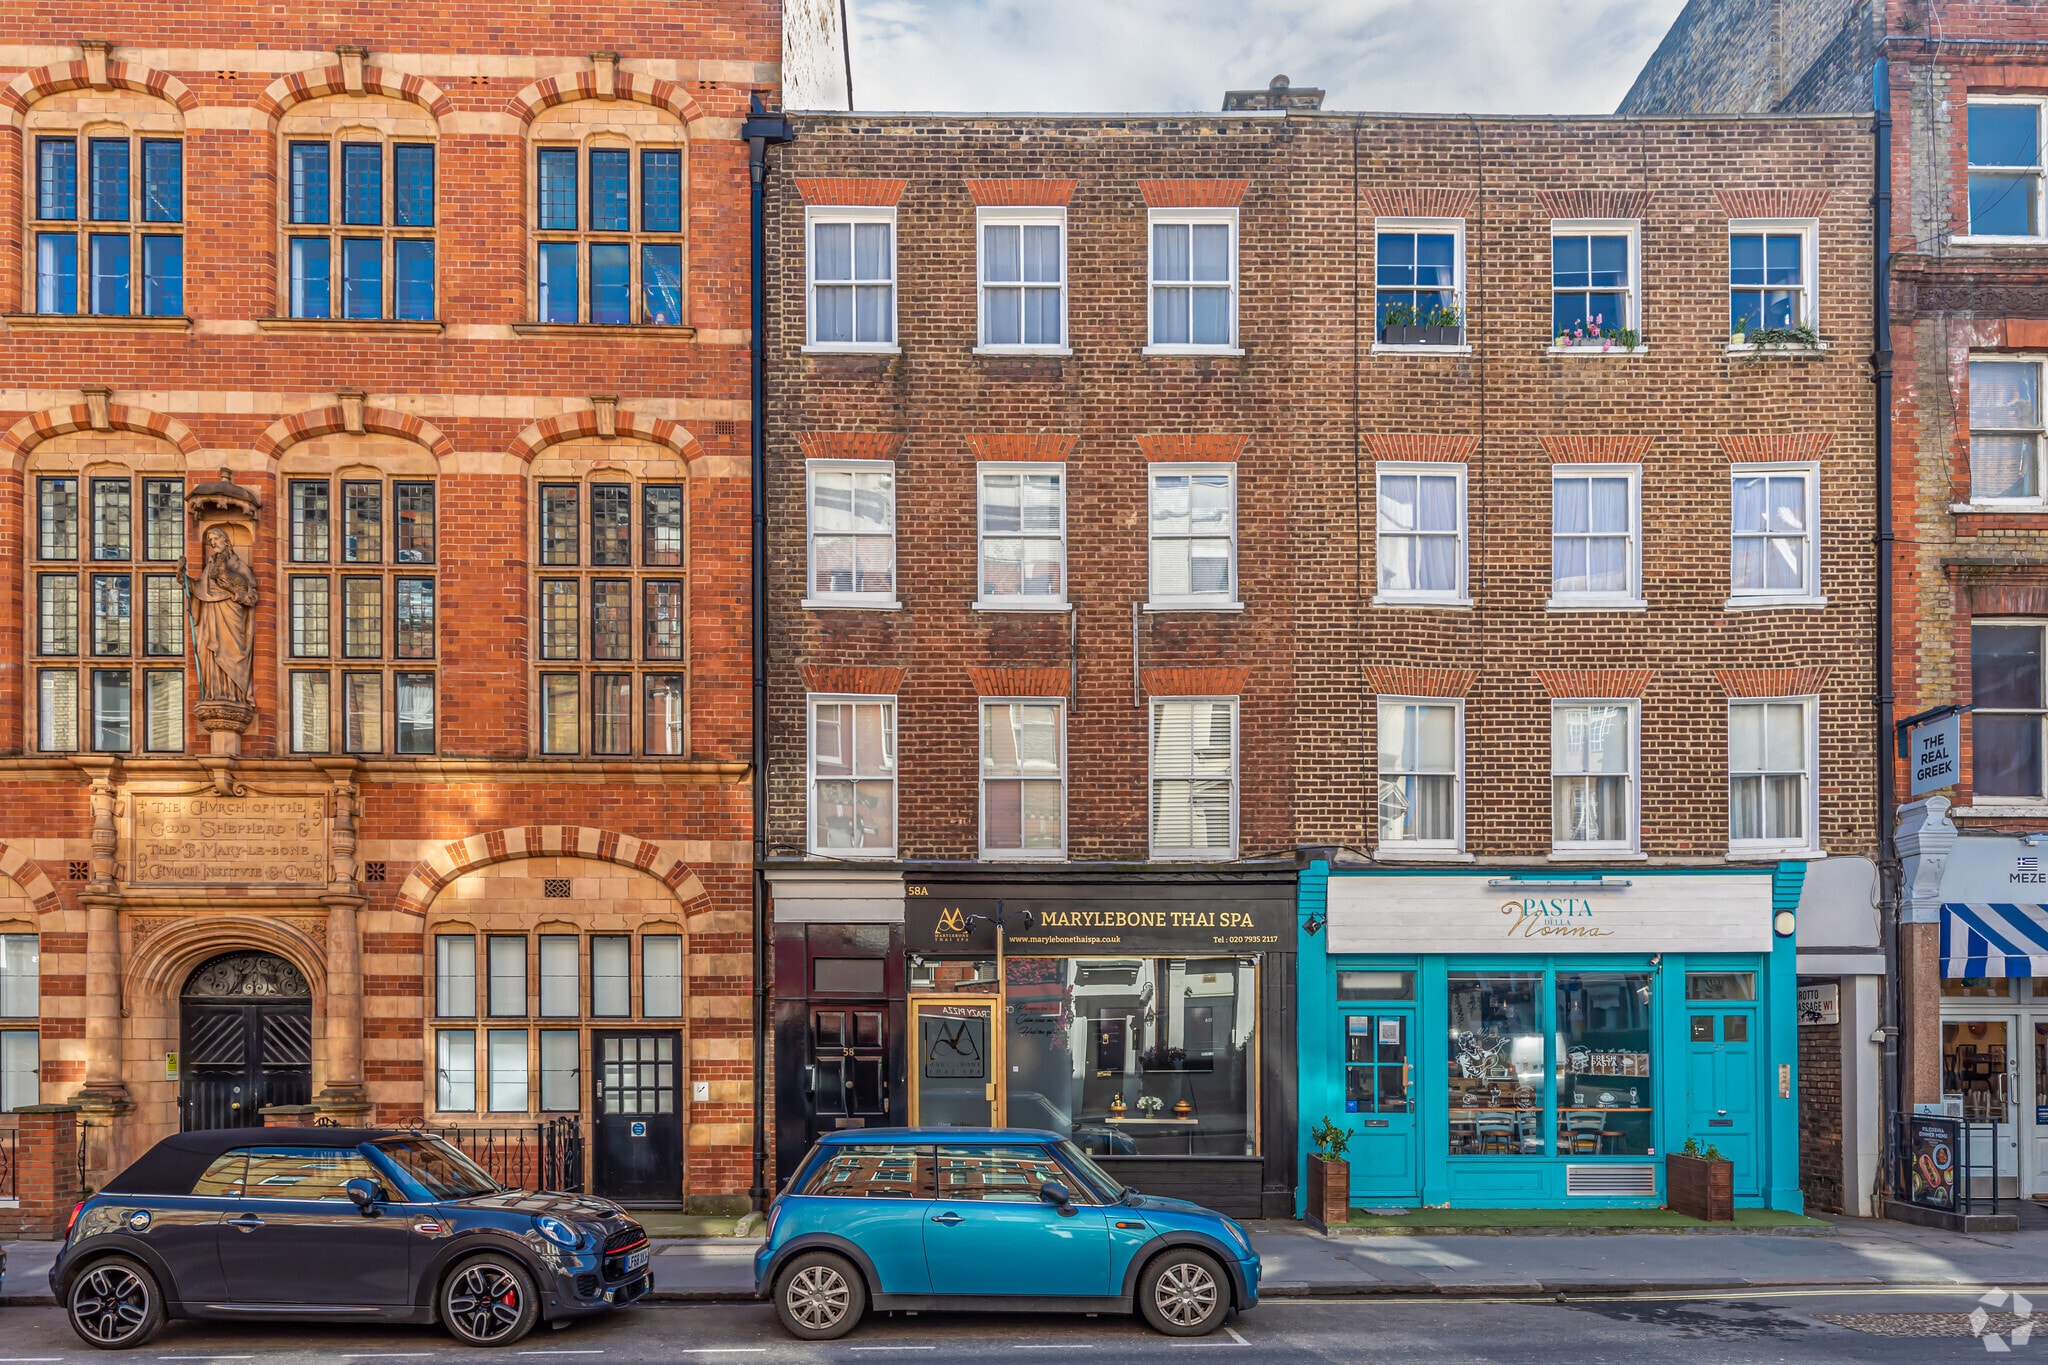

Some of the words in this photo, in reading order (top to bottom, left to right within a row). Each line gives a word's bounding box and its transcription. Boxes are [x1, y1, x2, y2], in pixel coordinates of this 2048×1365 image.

[1923, 734, 1944, 750] THE
[1921, 748, 1949, 765] REAL
[1917, 761, 1952, 781] GREEK
[152, 802, 180, 813] THE
[252, 803, 269, 813] OF
[277, 802, 305, 813] THE
[201, 821, 286, 837] SHEPHERD
[298, 822, 310, 837] &
[146, 844, 178, 855] THE
[269, 866, 279, 880] &
[2010, 873, 2046, 883] MEZE
[908, 886, 929, 896] 58A
[1523, 898, 1593, 917] PASTA
[1041, 911, 1167, 927] MARYLEBONE
[1170, 912, 1215, 927] THAI
[1220, 912, 1254, 928] SPA
[1501, 901, 1615, 937] Nonna
[1009, 935, 1121, 944] www.marylebonethaispa.co.uk
[1213, 936, 1224, 944] Tel
[1229, 935, 1243, 943] 020
[1244, 935, 1261, 943] 7935
[1262, 935, 1278, 943] 2117
[1797, 990, 1818, 1000] ROTTO
[1797, 1001, 1821, 1012] ASSAGE
[1823, 1000, 1833, 1010] W1
[843, 1048, 855, 1056] 58
